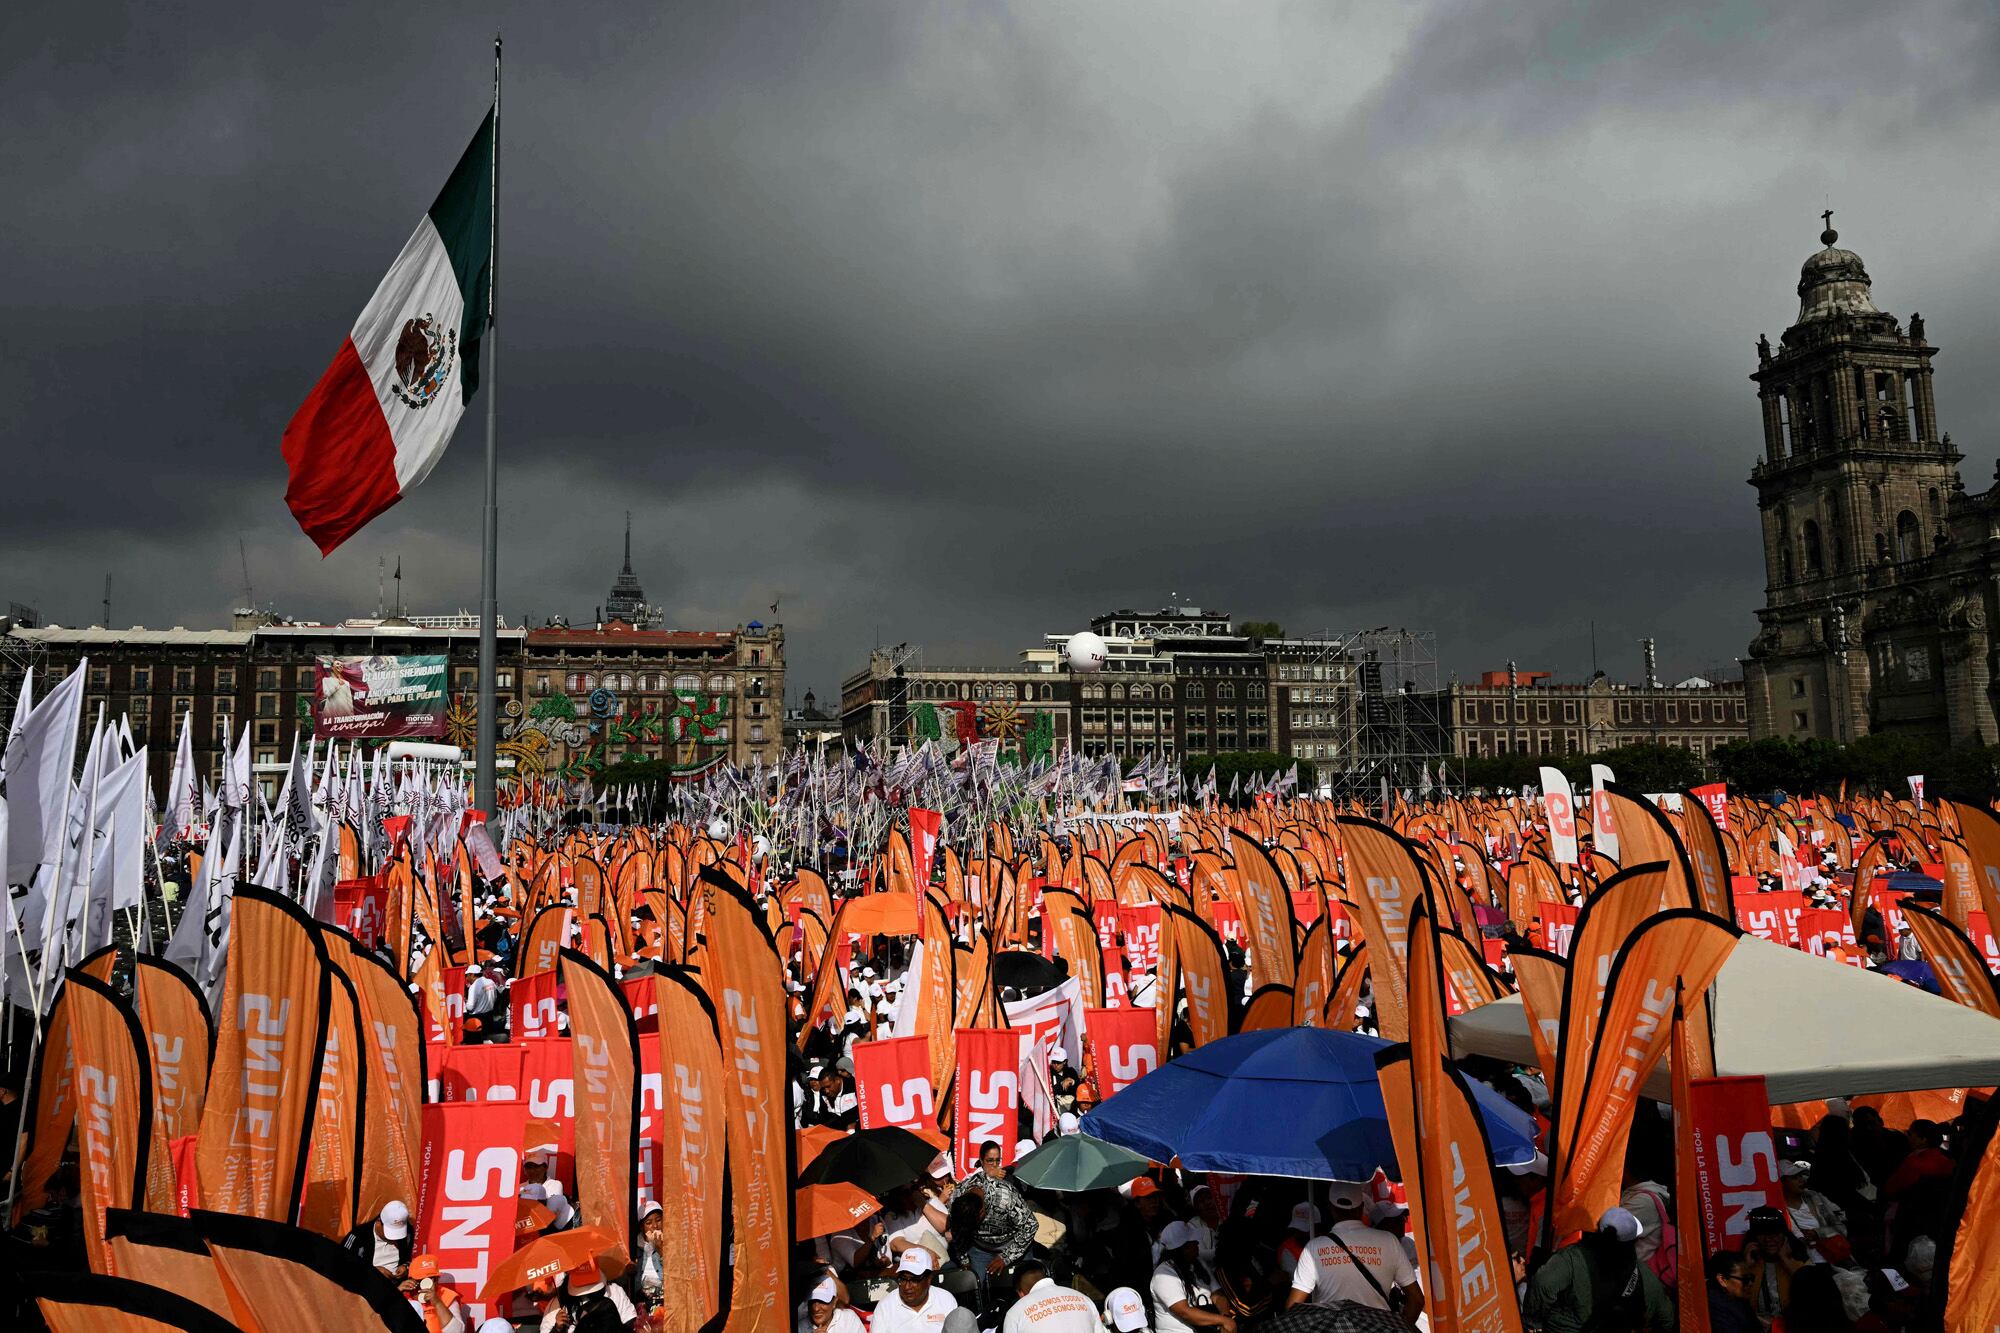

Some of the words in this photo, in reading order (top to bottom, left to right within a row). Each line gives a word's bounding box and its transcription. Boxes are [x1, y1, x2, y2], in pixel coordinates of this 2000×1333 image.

[400, 664, 445, 678] SHEINBAUM
[395, 684, 428, 696] GOBIERNO
[387, 694, 406, 704] PARA
[407, 693, 415, 701] EL
[405, 714, 434, 722] morena
[1711, 793, 1727, 830] SNTE
[1749, 909, 1778, 943] SN
[1784, 908, 1801, 943] SN
[539, 940, 557, 969] SN
[861, 1101, 867, 1111] LA
[1694, 1128, 1704, 1153] “POR
[424, 1141, 432, 1166] “POR
[1697, 1155, 1706, 1168] LA
[423, 1168, 429, 1181] LA
[1716, 1131, 1779, 1235] SN
[1700, 1170, 1714, 1229] EDUCACIÓN
[848, 1202, 872, 1218] SNTE
[515, 1217, 533, 1229] NTE
[1709, 1231, 1716, 1245] AL
[1317, 1246, 1330, 1256] UNO
[1354, 1245, 1377, 1255] TODOS
[1377, 1247, 1382, 1255] Y
[526, 1260, 559, 1280] SNTE
[1320, 1257, 1342, 1267] TODOS
[1367, 1257, 1382, 1266] UNO
[1024, 1304, 1038, 1316] UNO
[1038, 1296, 1060, 1308] SOMOS
[1030, 1307, 1052, 1323] TODOS
[1053, 1303, 1075, 1313] SOMOS
